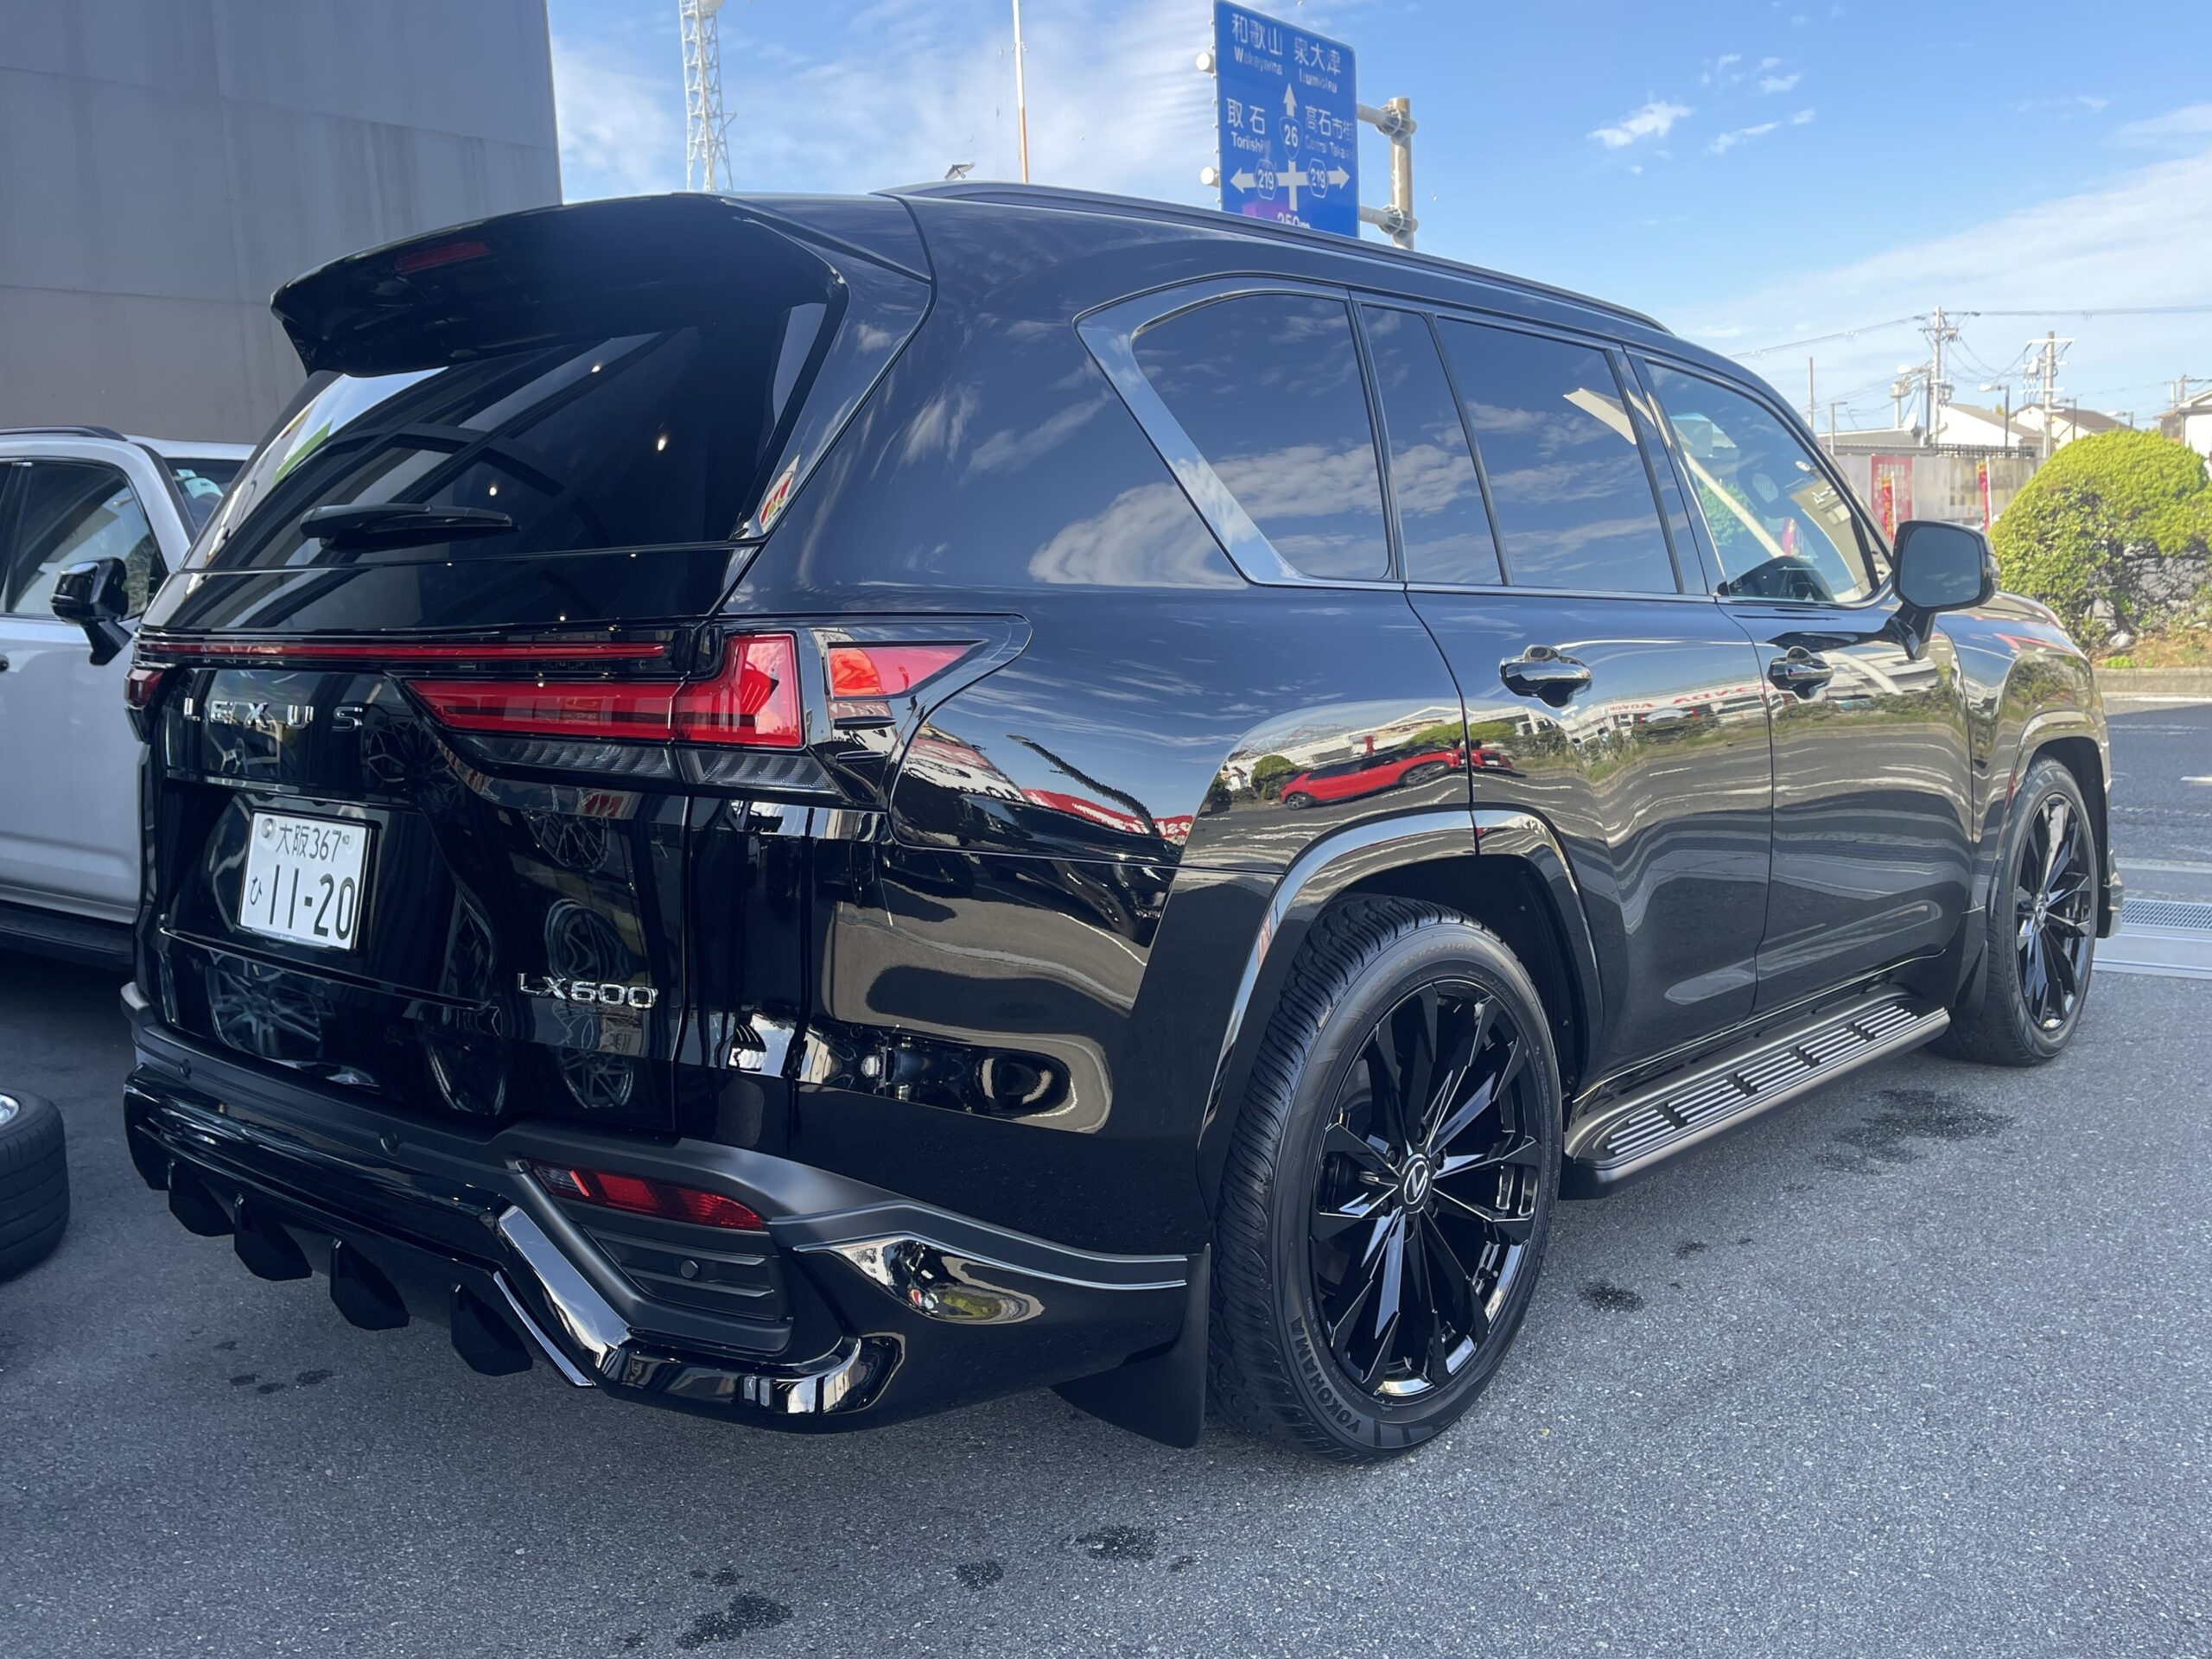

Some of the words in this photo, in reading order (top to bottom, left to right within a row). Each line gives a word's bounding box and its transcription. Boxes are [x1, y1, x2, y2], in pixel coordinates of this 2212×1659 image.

[1232, 13, 1283, 56] 和歌山
[1294, 36, 1342, 76] 泉大津
[1226, 97, 1266, 135] 取石
[1283, 123, 1299, 148] 26
[1257, 168, 1274, 191] 219
[1310, 168, 1325, 189] 219
[183, 696, 364, 733] LEXUS
[250, 875, 263, 906] ひ
[269, 864, 356, 940] 11-20
[518, 972, 659, 1009] LX600
[1290, 1315, 1363, 1434] YOKOHAMA
